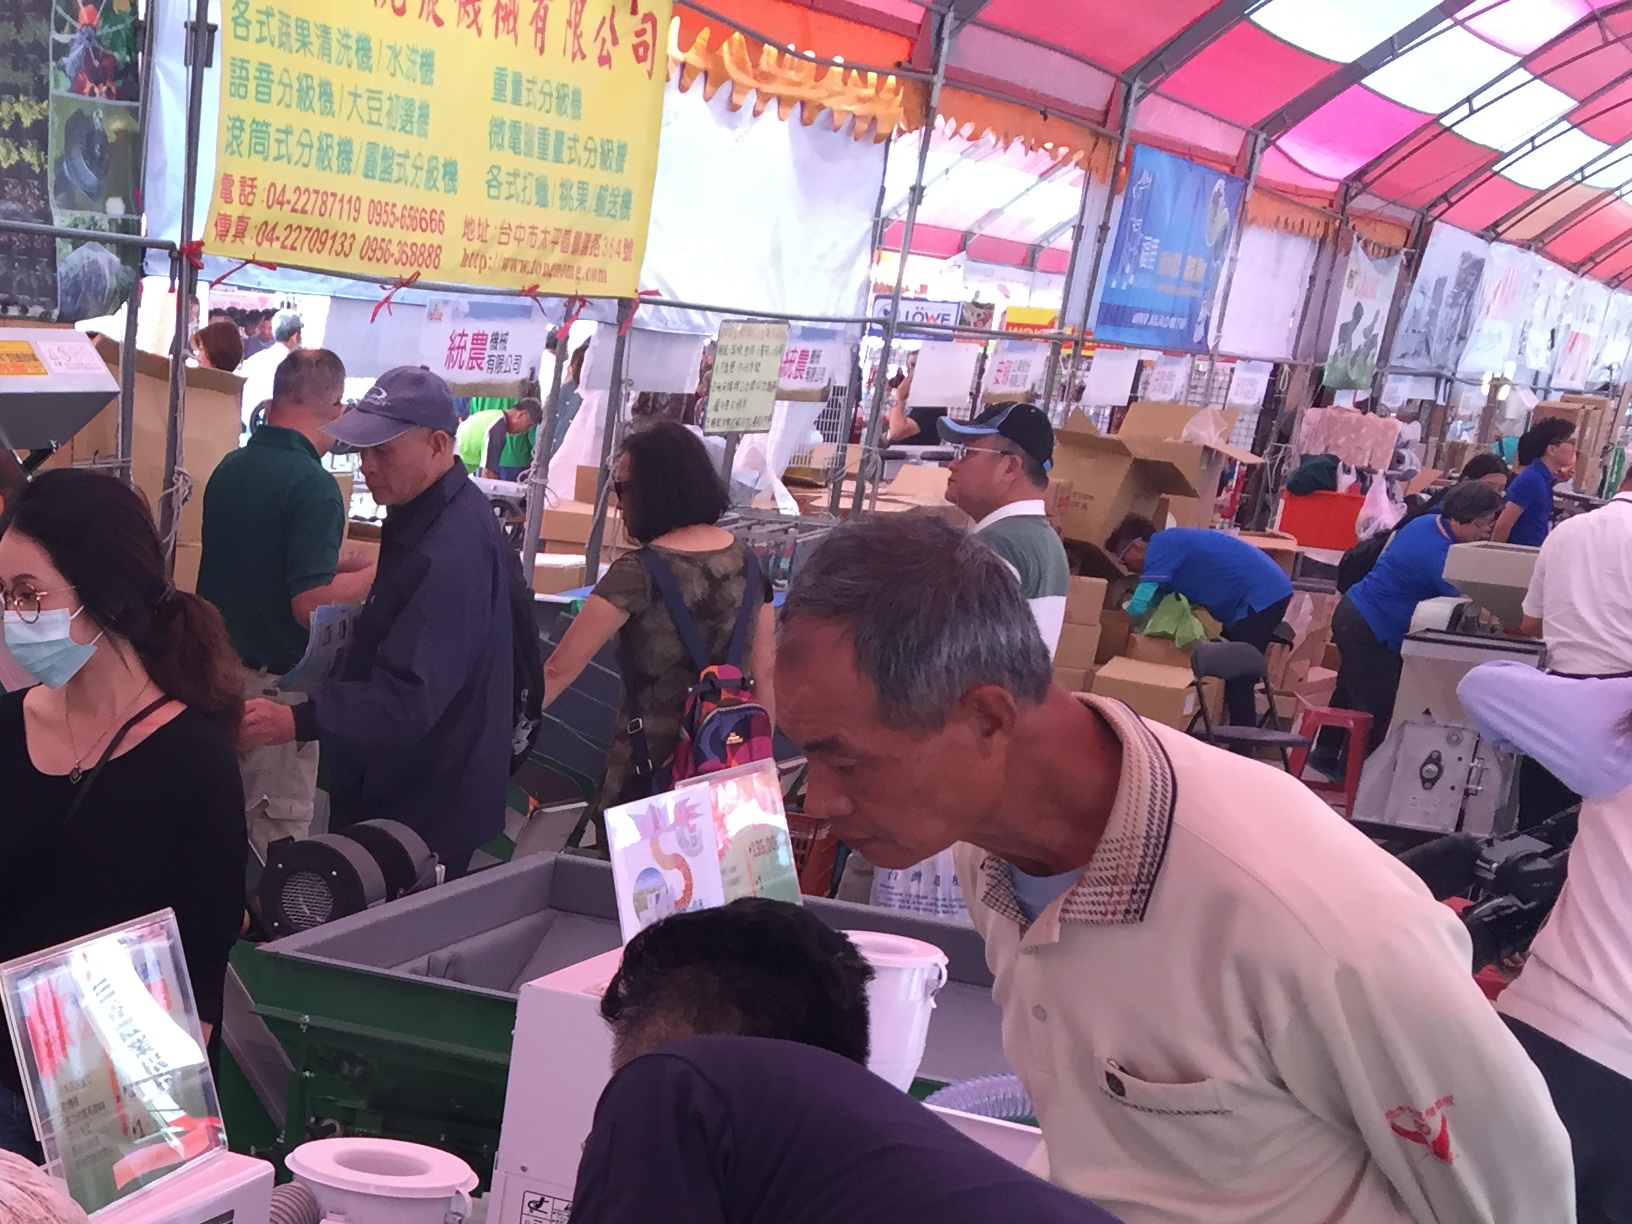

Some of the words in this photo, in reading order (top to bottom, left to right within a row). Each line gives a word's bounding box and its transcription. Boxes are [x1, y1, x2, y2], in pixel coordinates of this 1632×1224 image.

[374, 0, 658, 80] 機械有限公司
[444, 329, 489, 371] 統農
